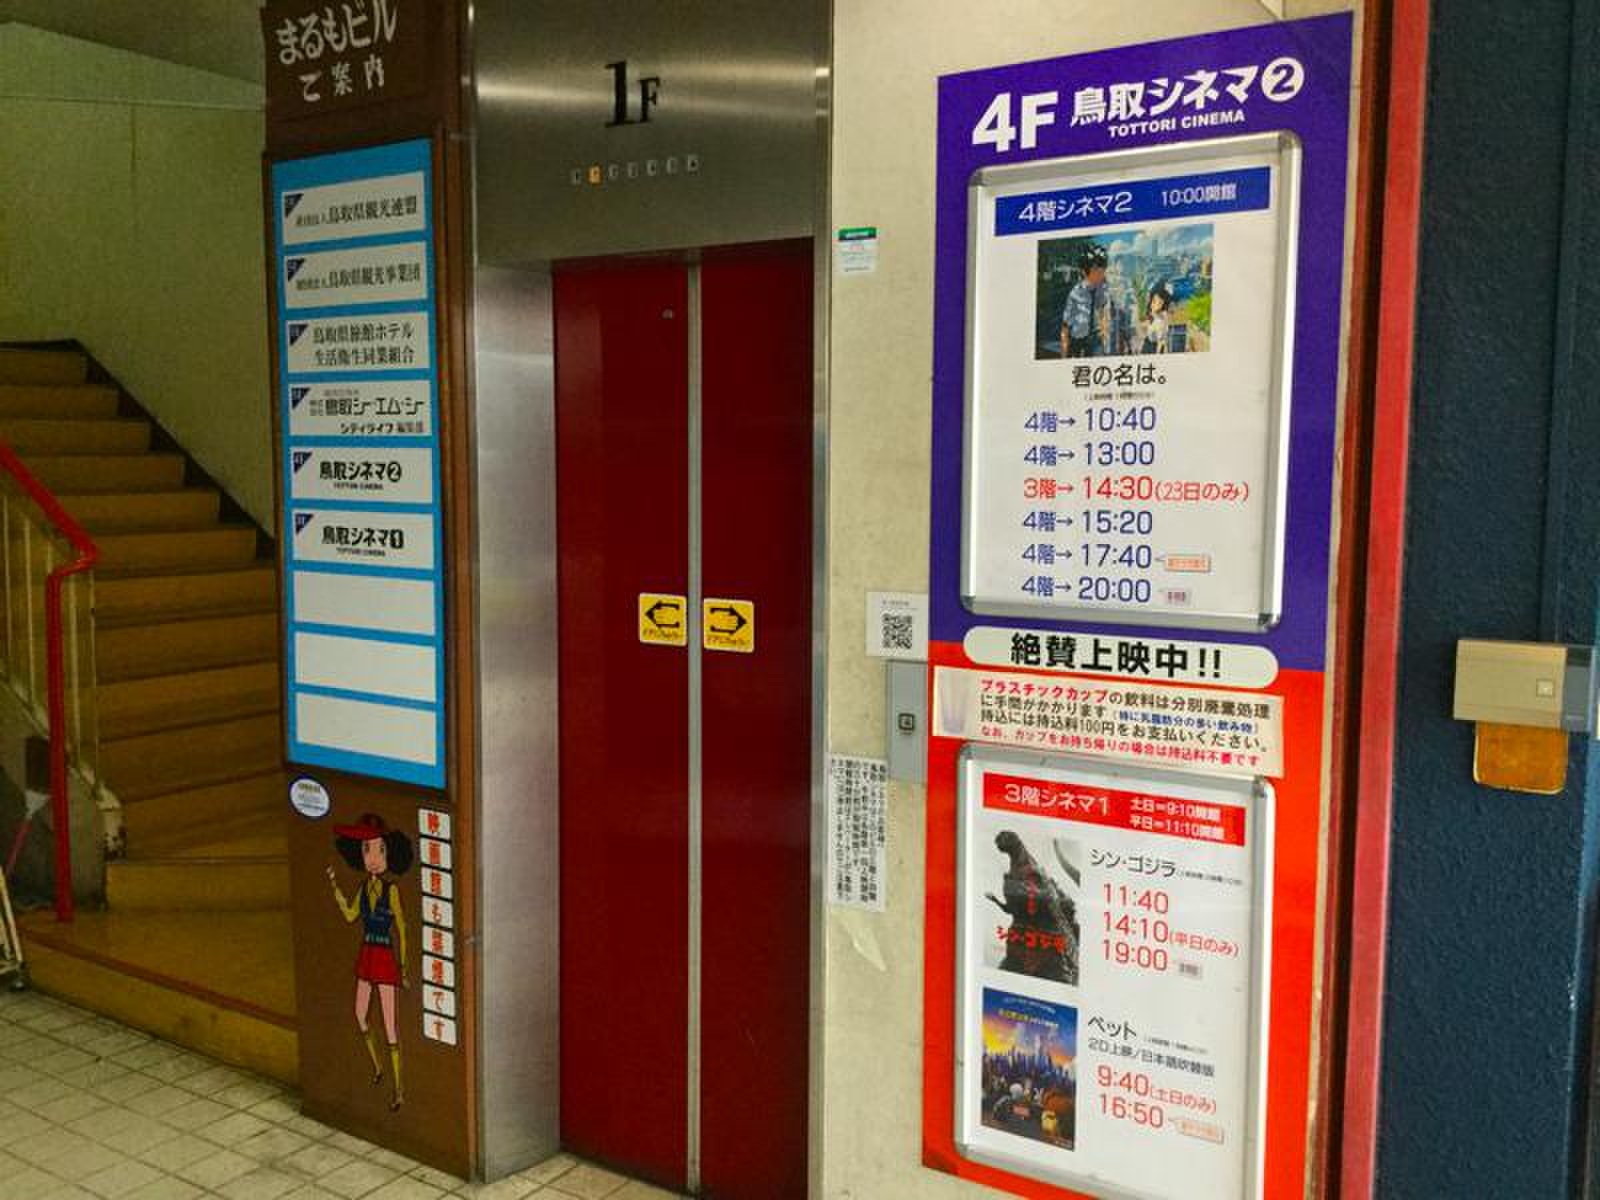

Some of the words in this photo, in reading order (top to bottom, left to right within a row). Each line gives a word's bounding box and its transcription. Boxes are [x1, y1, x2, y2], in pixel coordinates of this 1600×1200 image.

[604, 60, 660, 128] 1F
[972, 91, 1059, 152] 4F
[1108, 118, 1176, 138] TOTTORI
[1181, 109, 1245, 129] CINEMA
[1018, 191, 1132, 222] 4階シネマ2
[1072, 364, 1167, 387] 君の名は。
[1084, 406, 1156, 431] 10:40
[1084, 441, 1155, 465] 13:00
[1082, 510, 1153, 534] 15:20
[1081, 543, 1152, 568] 17:40
[1078, 576, 1151, 602] 20:00
[1004, 783, 1109, 815] 3階シネマ1
[1103, 883, 1169, 914] 11:40
[1102, 939, 1168, 971] 19:00
[1098, 1093, 1164, 1128] 16:50
